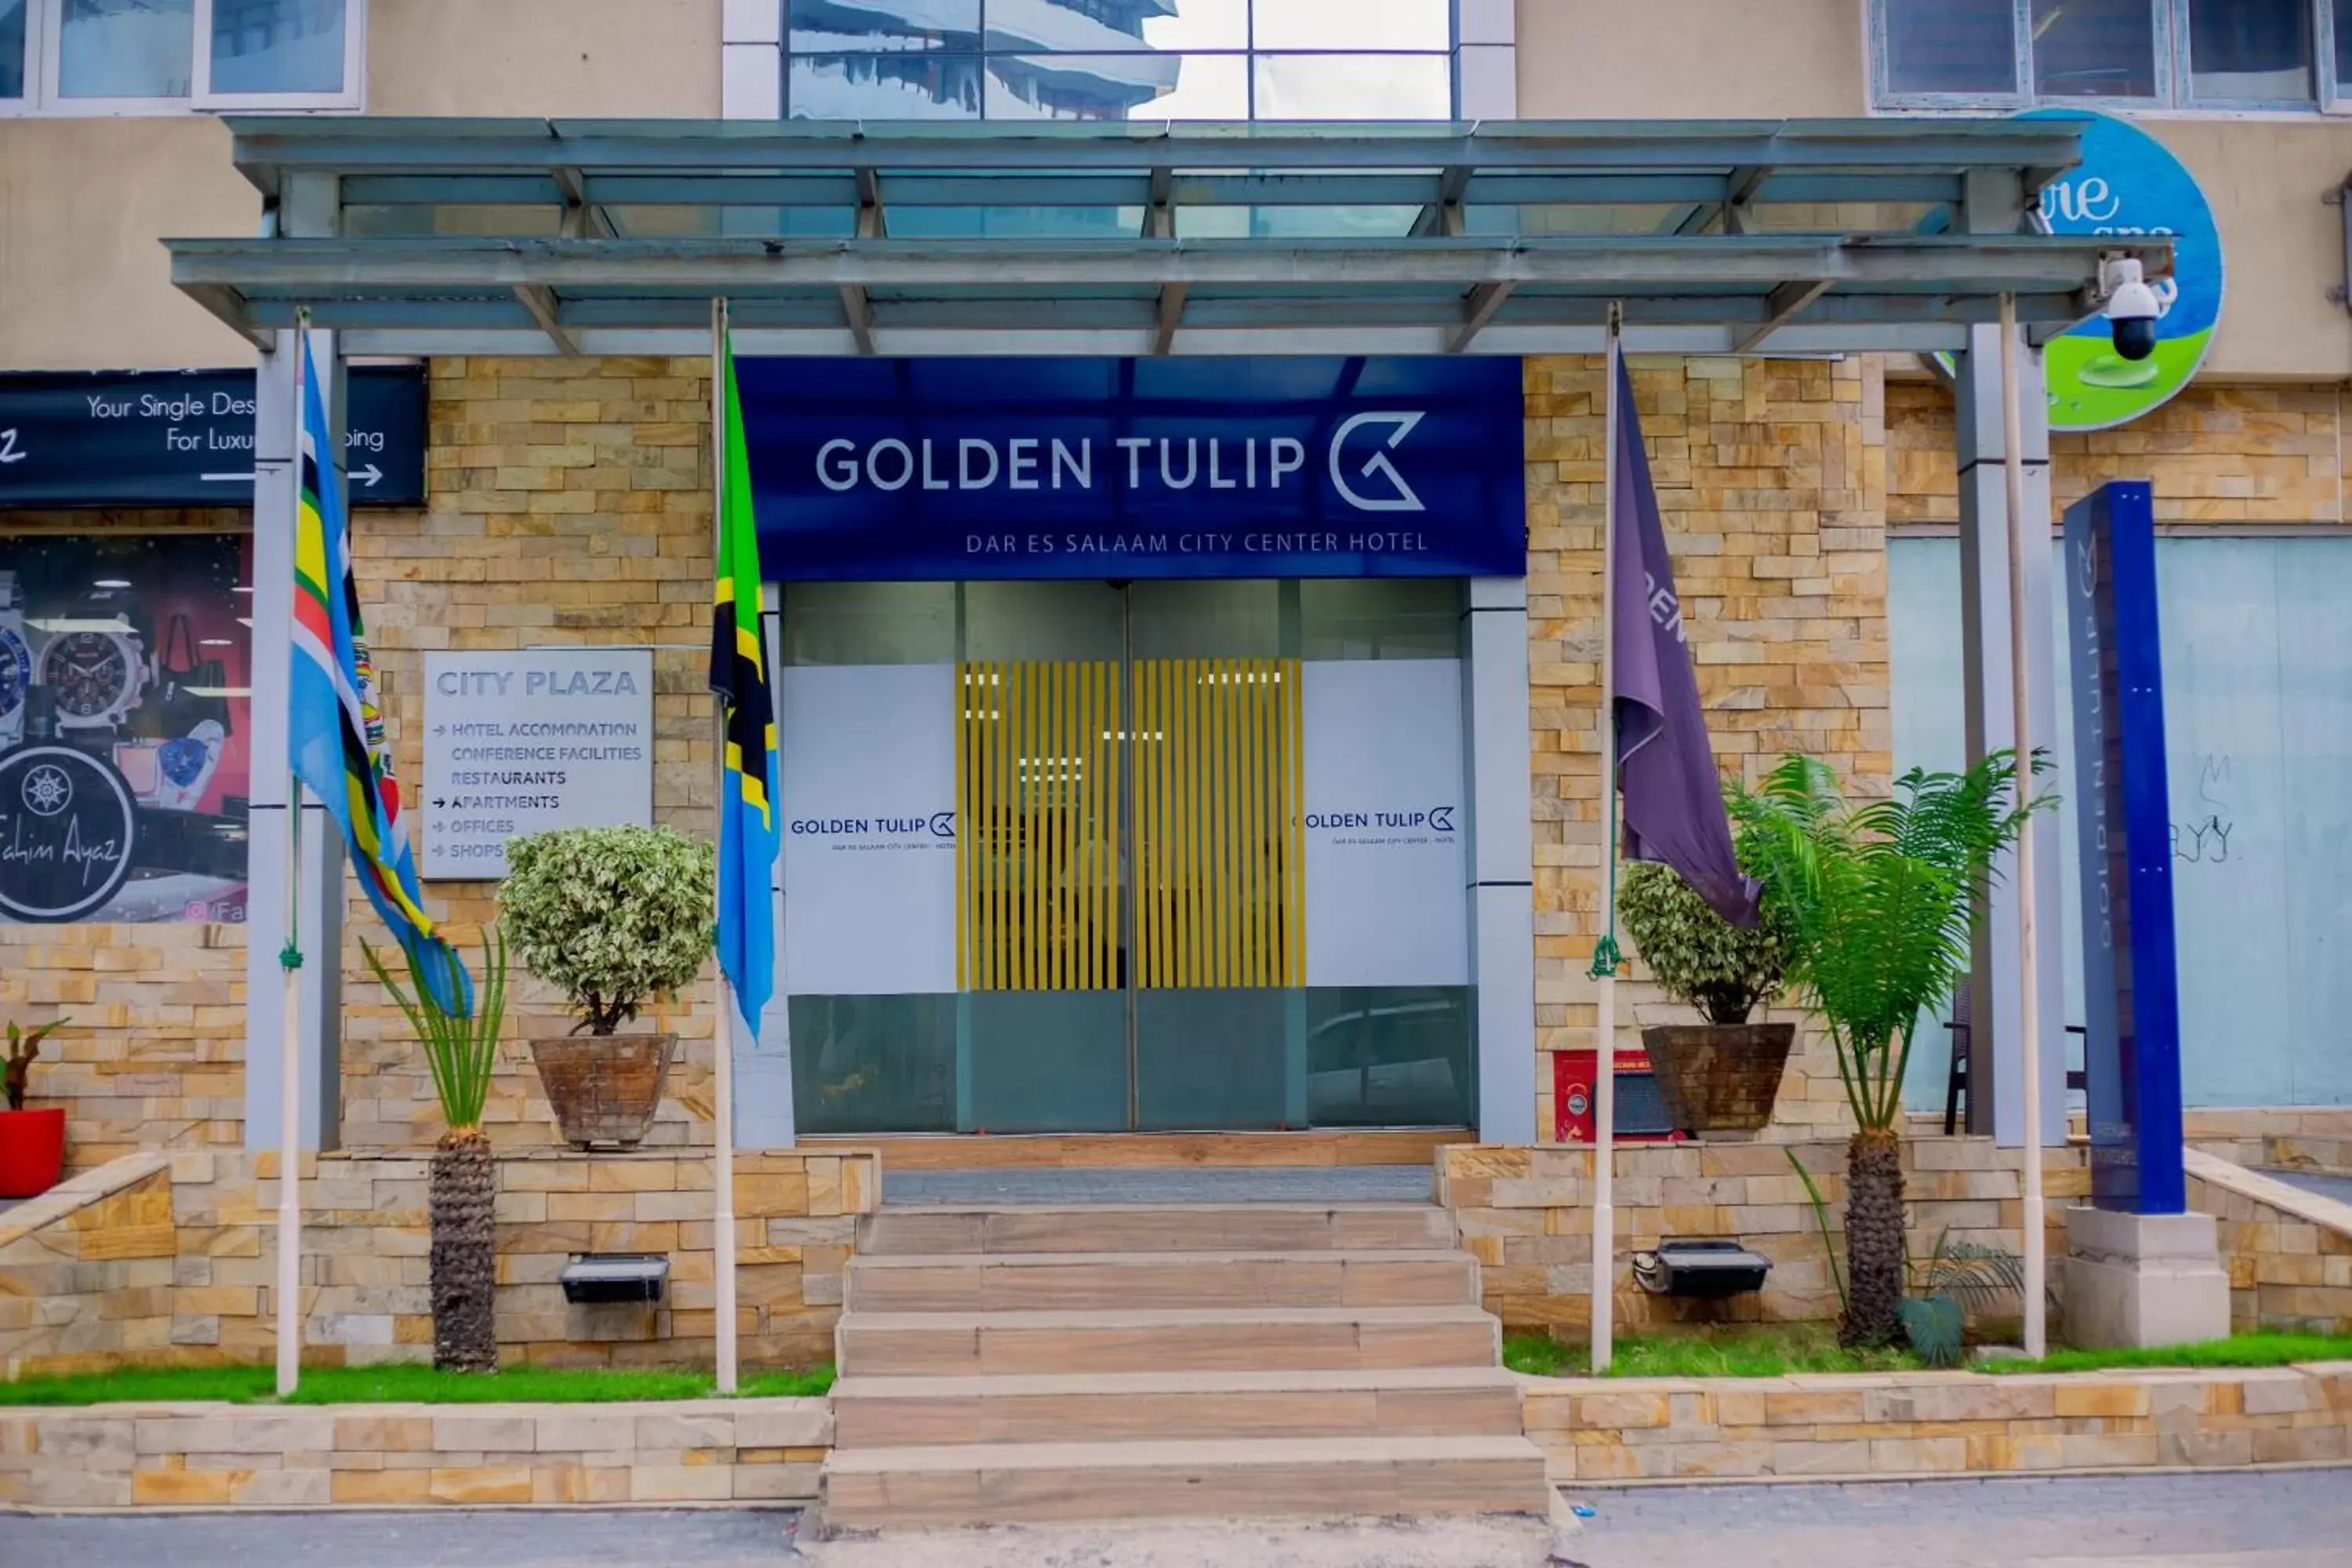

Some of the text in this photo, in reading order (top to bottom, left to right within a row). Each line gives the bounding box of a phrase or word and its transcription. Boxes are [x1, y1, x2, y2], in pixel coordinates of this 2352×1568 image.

[87, 391, 256, 421] Your Single Des
[167, 427, 201, 451] For
[209, 426, 254, 450] Luxu
[816, 437, 1305, 492] GOLDEN TULIP
[966, 532, 1428, 553] DAR ES SALAAM CITY CENTER HOTEL
[436, 670, 638, 697] CITY PLAZA
[452, 723, 637, 738] HOTEL ACCOMODATION
[452, 746, 642, 761] CONFERENCE FACILITIES
[452, 771, 566, 786] RESTAURANTS
[452, 795, 560, 810] APARTMENTS
[451, 819, 514, 834] OFFICES
[791, 818, 926, 835] GOLDEN TULIP
[1374, 812, 1425, 827] TULIP
[451, 844, 504, 858] SHOPS
